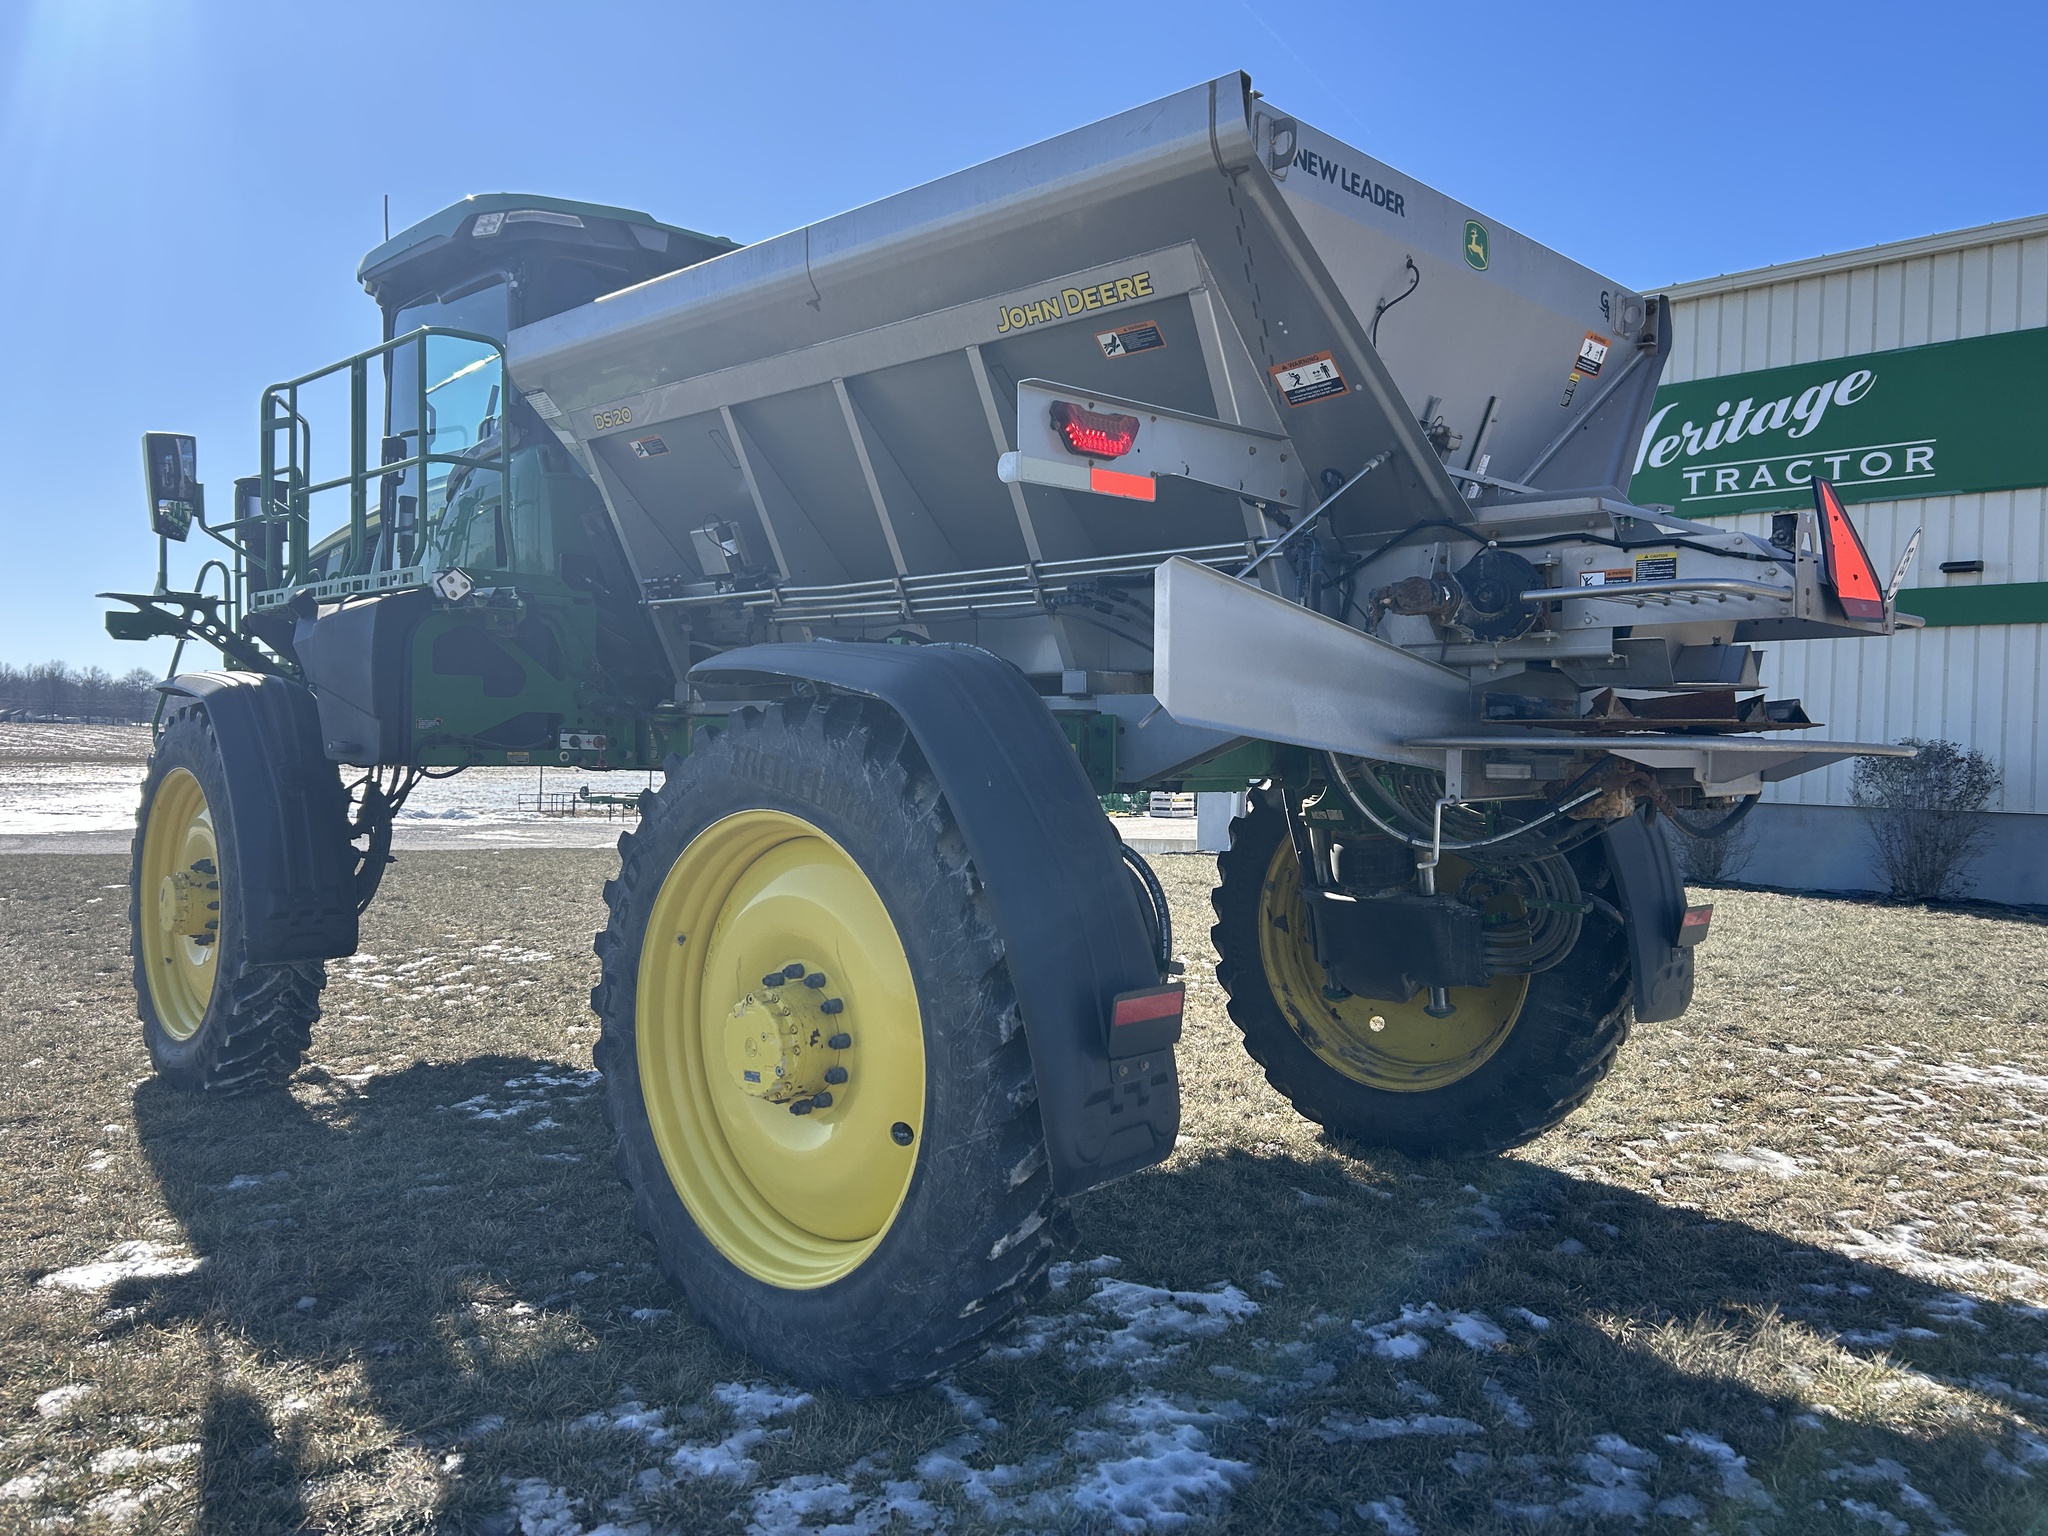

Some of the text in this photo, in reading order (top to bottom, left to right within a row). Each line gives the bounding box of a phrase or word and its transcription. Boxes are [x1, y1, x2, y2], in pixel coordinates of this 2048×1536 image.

[1293, 149, 1405, 218] NEW LEADER
[997, 271, 1154, 333] JOHN DEERE
[1288, 355, 1319, 369] WARNING
[1682, 446, 1935, 495] TRACTOR
